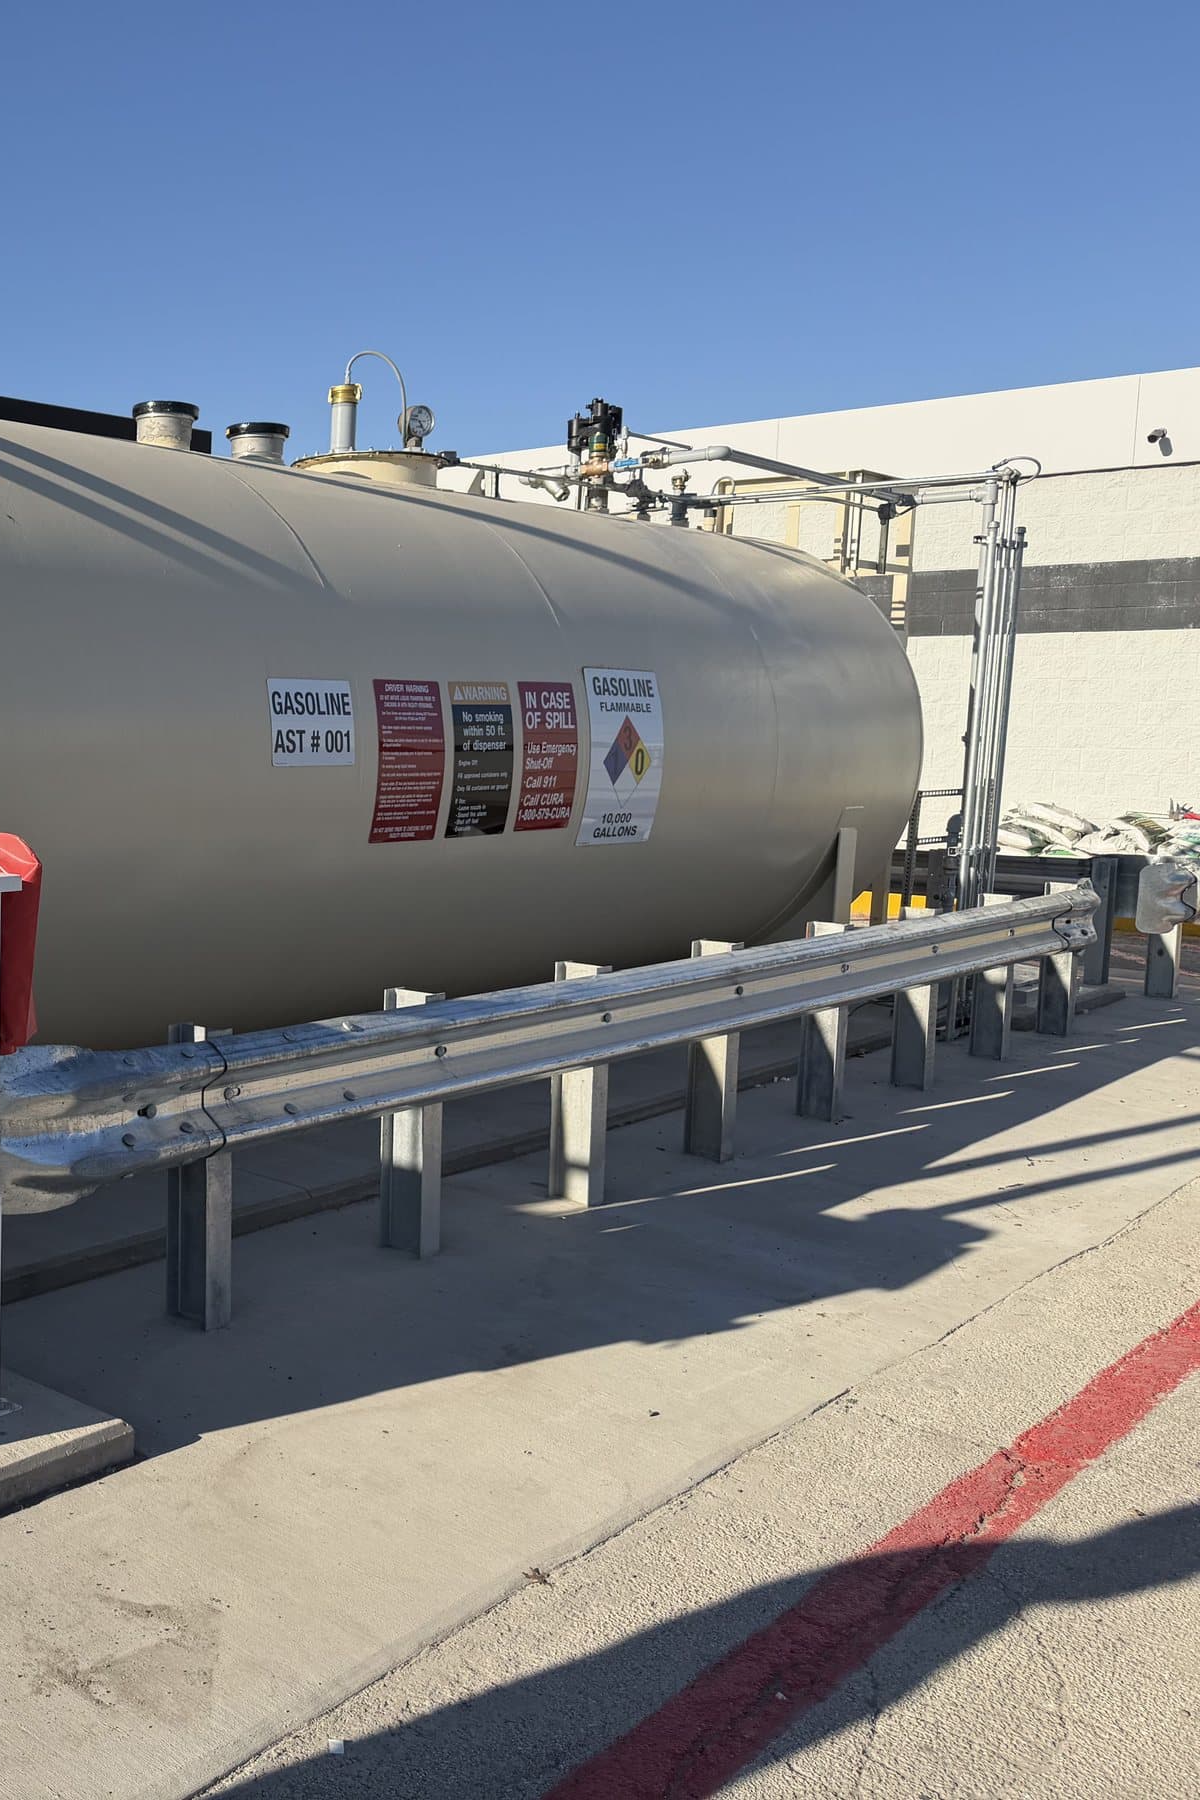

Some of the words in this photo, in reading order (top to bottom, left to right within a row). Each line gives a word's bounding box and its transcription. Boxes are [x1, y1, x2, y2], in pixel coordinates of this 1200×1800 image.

[463, 686, 507, 701] WARNING
[592, 676, 655, 698] GASOLINE
[271, 691, 351, 716] GASOLINE
[525, 691, 537, 709] IN
[541, 691, 571, 709] CASE
[600, 702, 652, 713] FLAMMABLE
[462, 712, 473, 722] No
[475, 712, 504, 724] smoking
[525, 712, 541, 729] OF
[545, 712, 575, 729] SPILL
[463, 726, 483, 737] within
[485, 725, 496, 737] 50
[274, 729, 306, 753] AST
[325, 729, 351, 753] 001
[623, 726, 632, 750] 3
[462, 740, 471, 751] of
[472, 740, 506, 752] dispenser
[527, 742, 541, 754] Use
[542, 742, 577, 756] Emergency
[525, 757, 553, 769] Shut-Off
[635, 748, 644, 776] 0
[525, 776, 542, 788] Call
[543, 776, 557, 788] 911
[523, 793, 540, 806] Call
[540, 793, 564, 806] CURA
[518, 808, 570, 821] 1-800-579-CURA
[601, 813, 632, 825] 10,000
[593, 826, 637, 839] GALLONS
